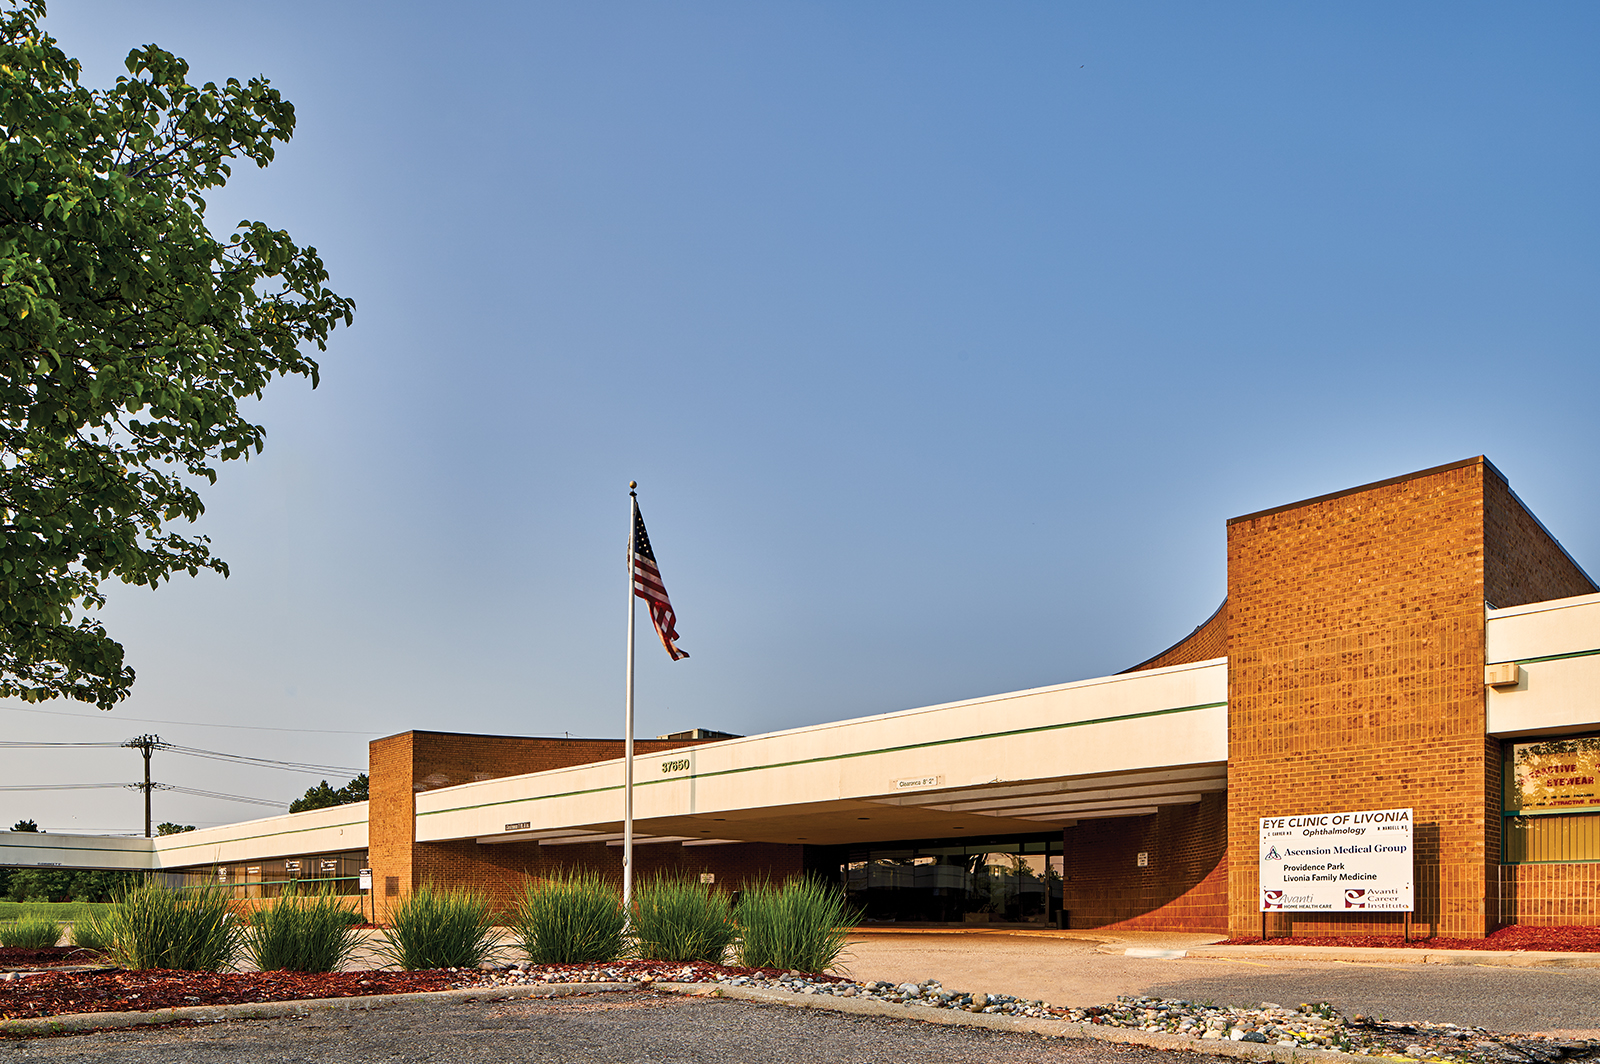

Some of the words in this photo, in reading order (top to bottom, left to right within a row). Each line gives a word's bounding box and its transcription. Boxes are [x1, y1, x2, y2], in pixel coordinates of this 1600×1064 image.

[661, 758, 690, 773] 37650
[1547, 776, 1595, 787] EYEWEAR
[1263, 819, 1285, 829] EYE
[1288, 816, 1329, 828] CLINIC
[1332, 815, 1350, 825] OF
[1354, 811, 1409, 824] LIVONIA
[1302, 827, 1367, 837] Ophthalmology
[1284, 846, 1331, 856] Ascension
[1333, 844, 1372, 854] Medical
[1374, 843, 1408, 854] Group
[1283, 863, 1326, 872] Providence
[1327, 862, 1345, 870] Park
[1283, 873, 1310, 882] Livonia
[1312, 873, 1338, 882] Family
[1339, 872, 1378, 881] Medicine
[1367, 887, 1398, 895] Avanti
[1278, 893, 1314, 903] Avanti
